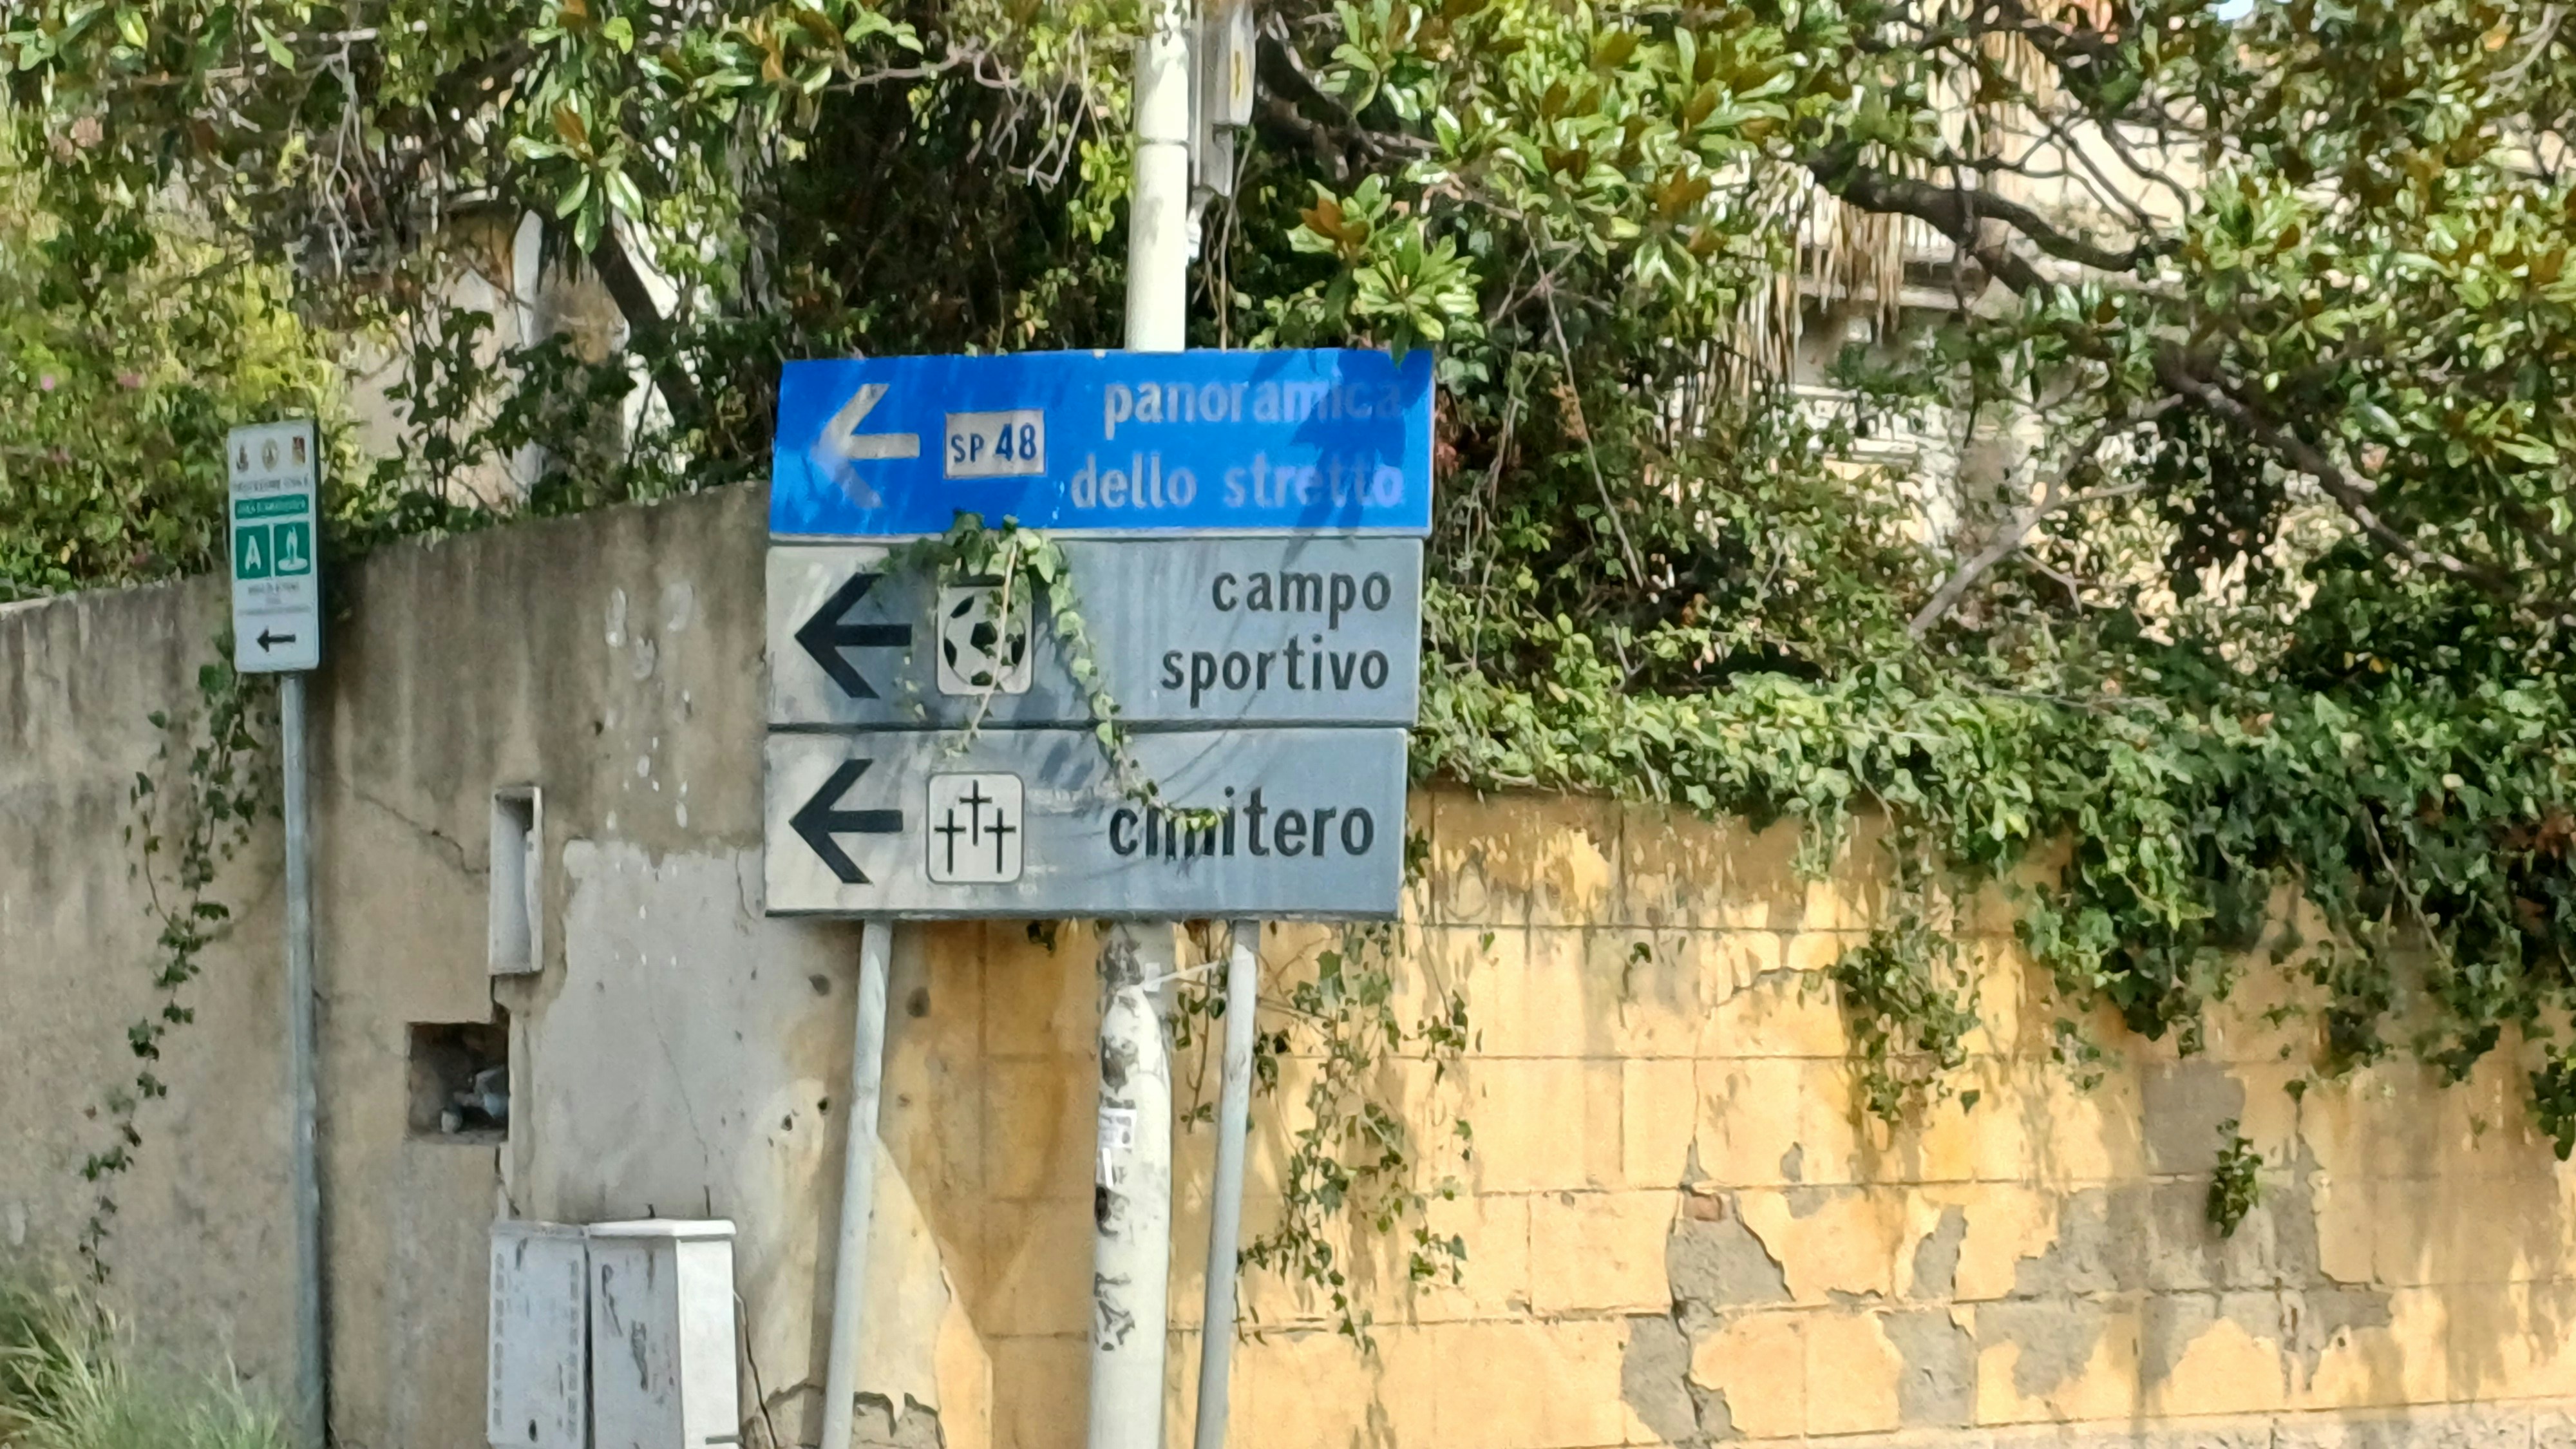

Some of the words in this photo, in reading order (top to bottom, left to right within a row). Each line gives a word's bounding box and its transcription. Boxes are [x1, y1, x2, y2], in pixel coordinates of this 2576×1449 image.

[1104, 380, 1403, 440] panoramica
[951, 433, 985, 464] SP
[995, 422, 1037, 462] 48
[1070, 453, 1197, 509] dello
[1224, 452, 1405, 509] stretto
[1212, 571, 1392, 631] campo
[1160, 632, 1389, 709] sportivo
[1108, 786, 1375, 857] cimitero
